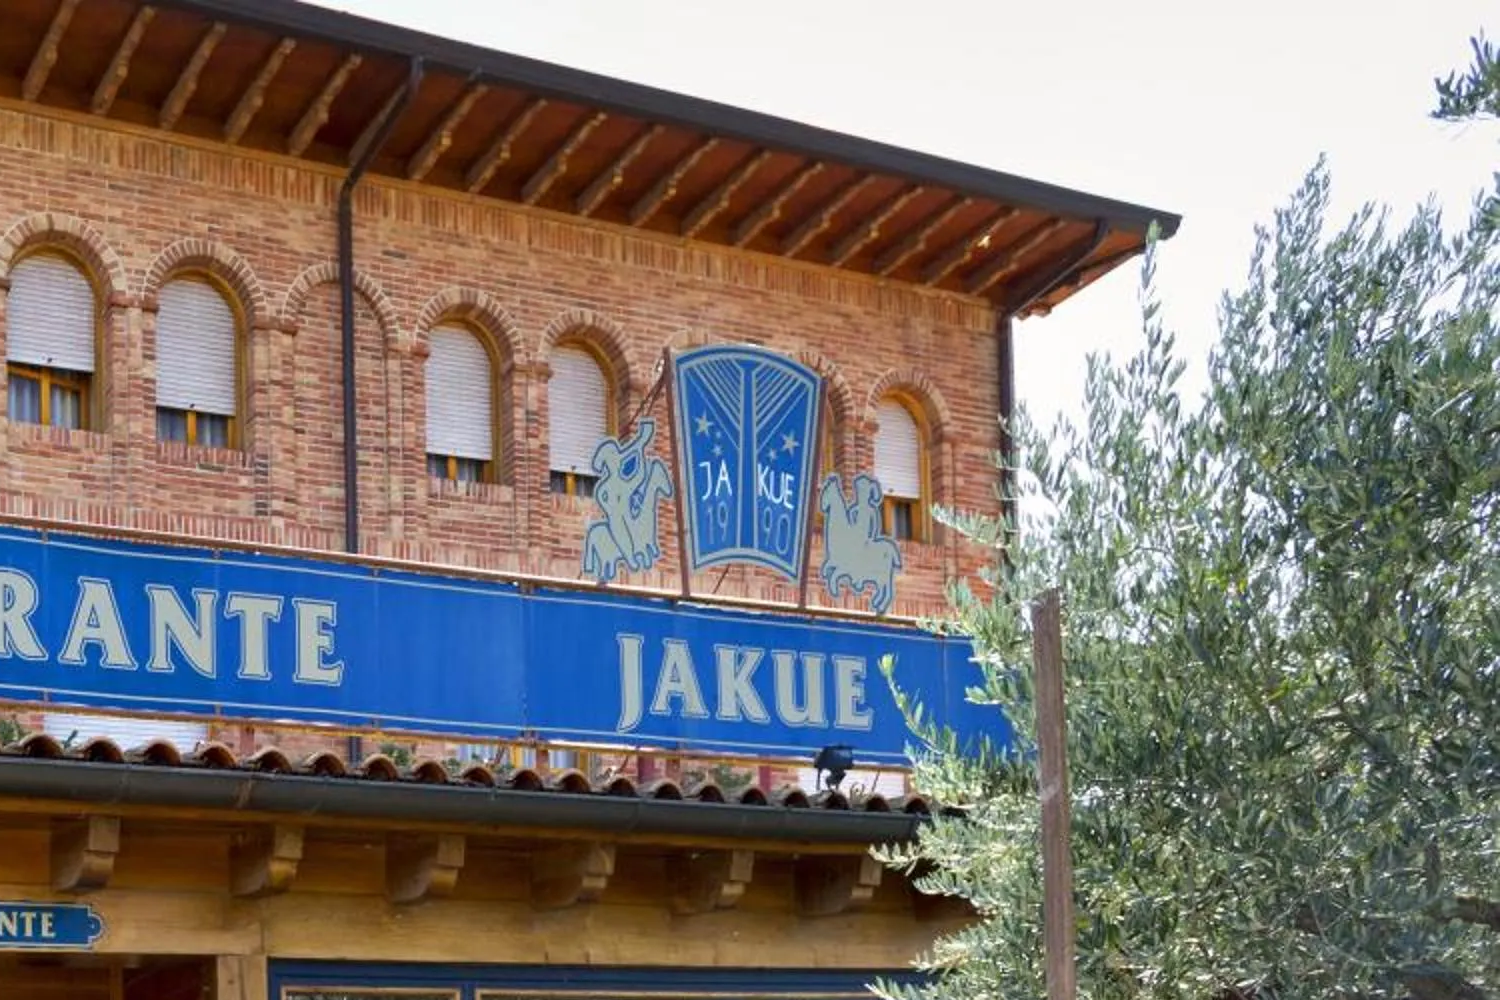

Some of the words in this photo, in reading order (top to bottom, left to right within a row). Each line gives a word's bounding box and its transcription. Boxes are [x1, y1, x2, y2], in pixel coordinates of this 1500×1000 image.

[699, 459, 733, 501] JA
[757, 462, 795, 509] KUE
[706, 502, 729, 546] 19
[763, 506, 792, 556] 90
[616, 632, 873, 734] JAKUE
